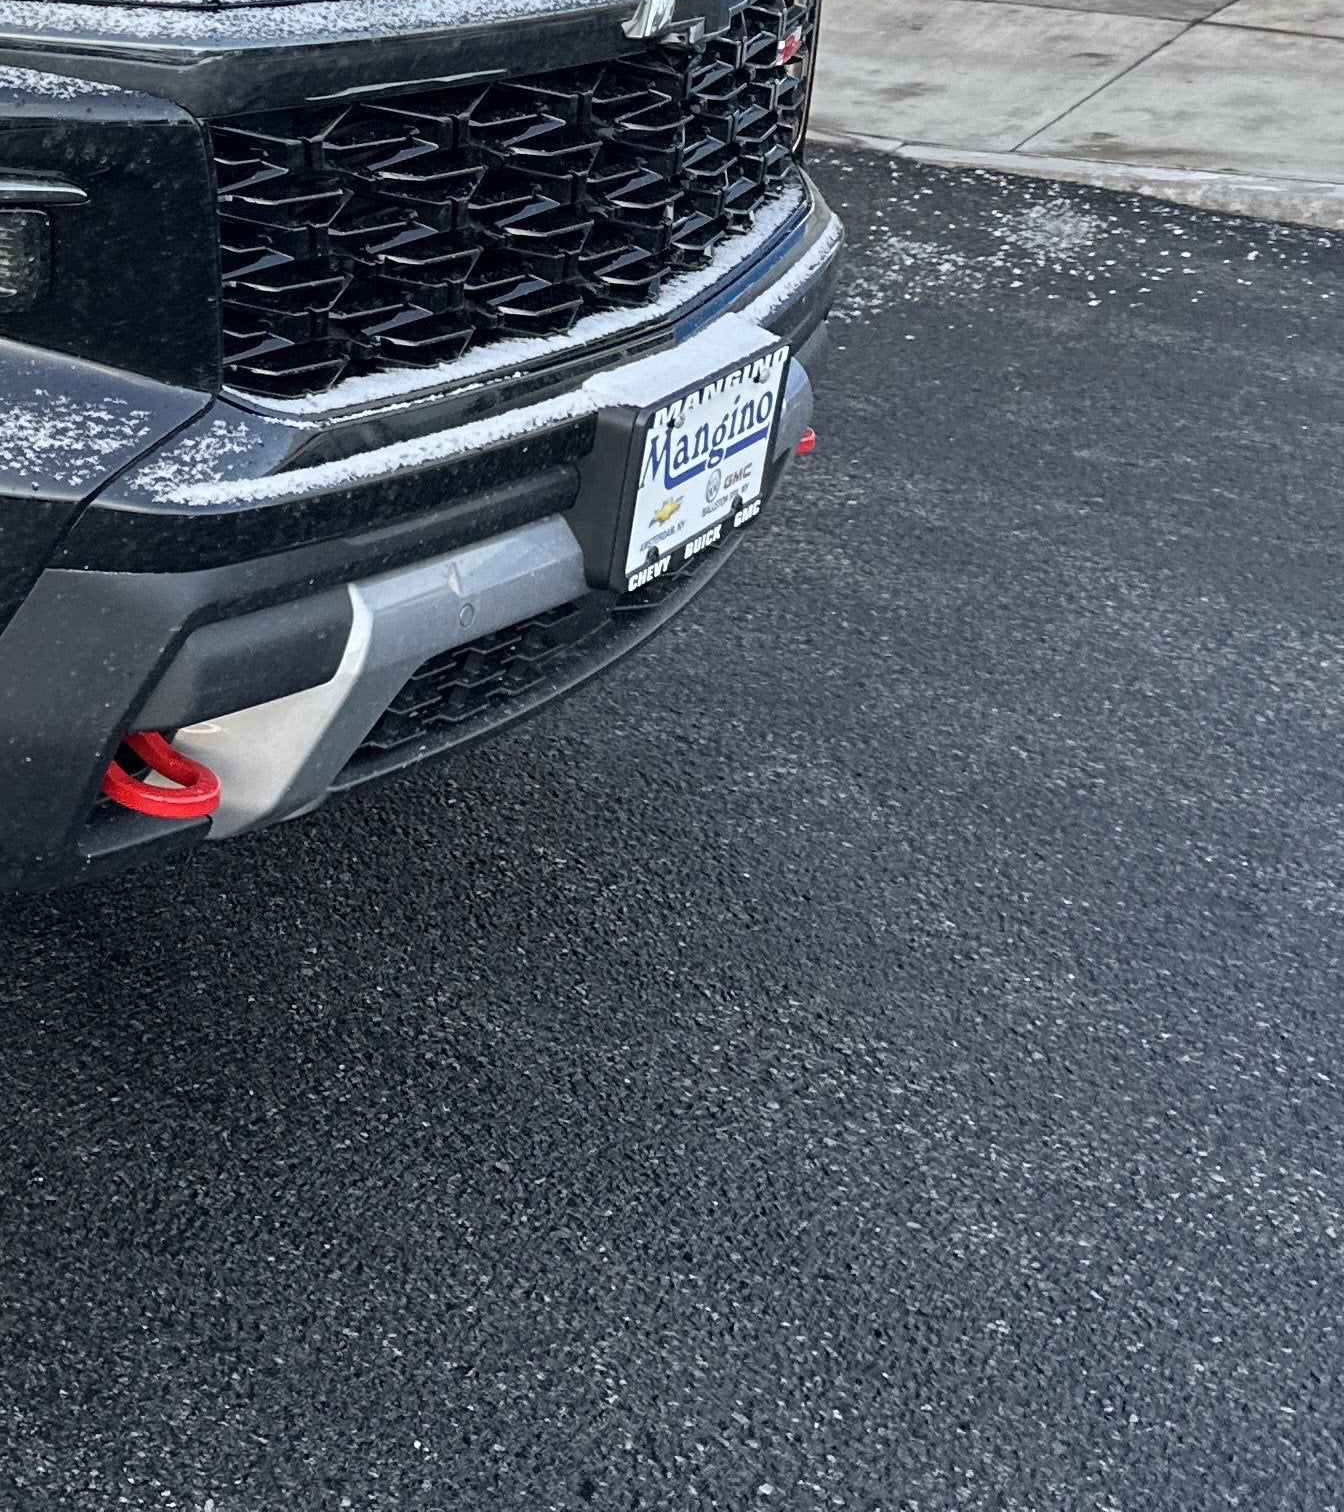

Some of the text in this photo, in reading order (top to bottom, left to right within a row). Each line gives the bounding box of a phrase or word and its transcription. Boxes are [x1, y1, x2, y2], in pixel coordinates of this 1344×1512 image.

[653, 345, 790, 429] MANGINO
[639, 390, 775, 489] Mangino
[723, 462, 753, 490] GMC
[628, 499, 762, 592] CHEVY BUICK GMC
